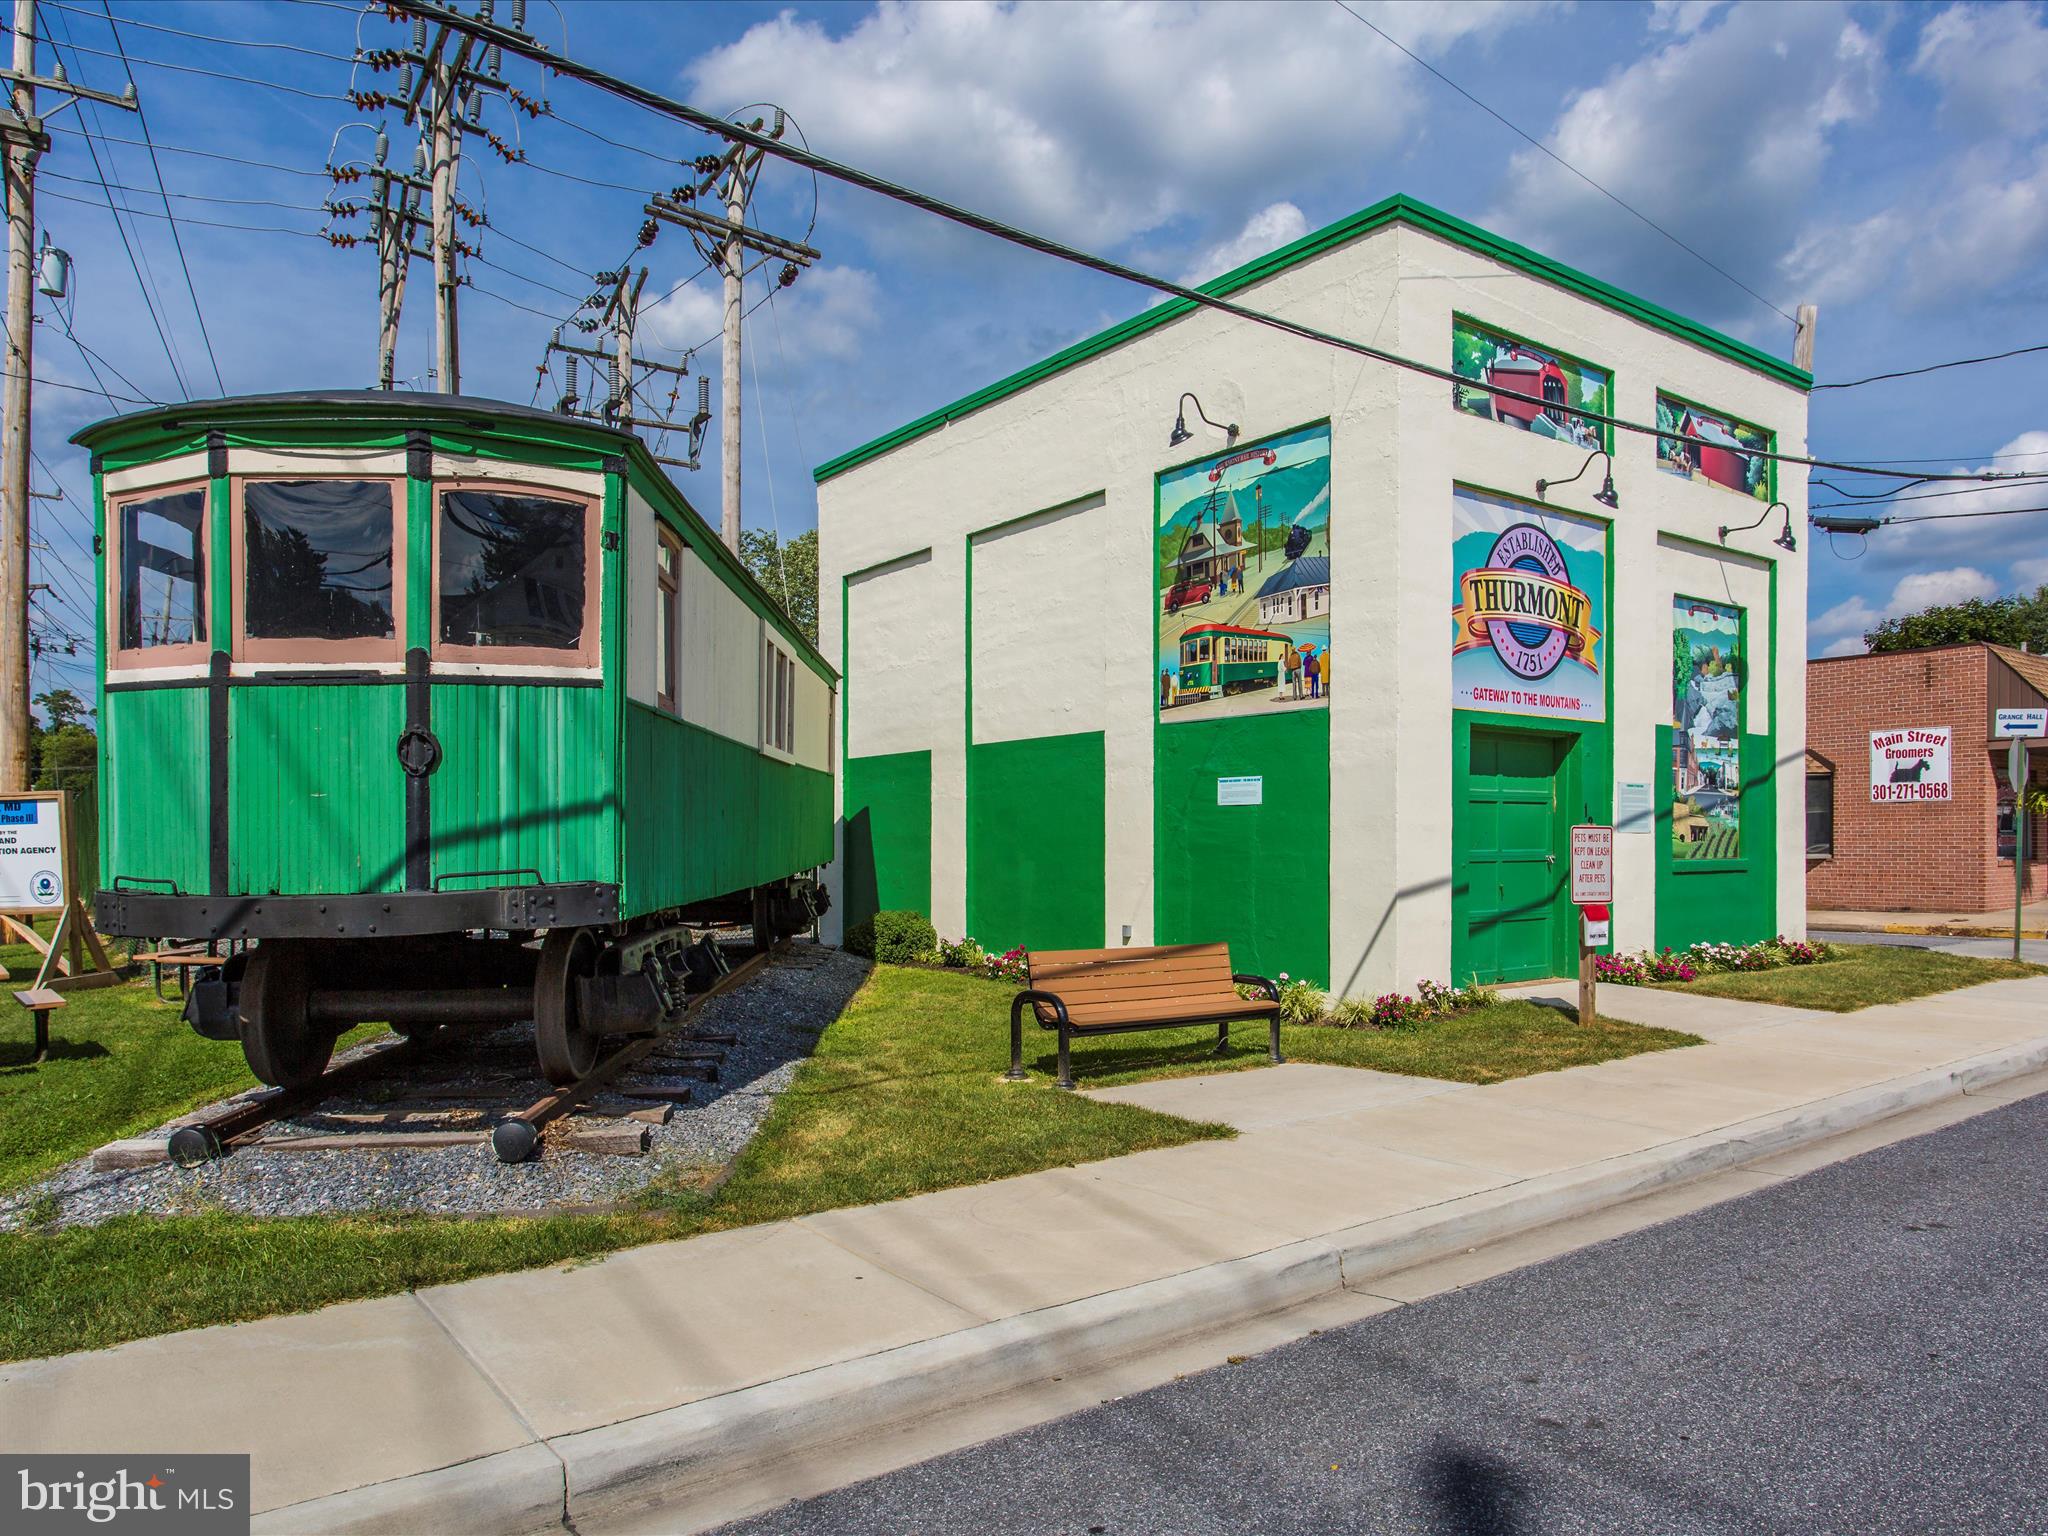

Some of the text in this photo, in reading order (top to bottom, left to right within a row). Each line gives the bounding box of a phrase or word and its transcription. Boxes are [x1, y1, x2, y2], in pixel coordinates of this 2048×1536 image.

[1496, 532, 1562, 576] ESTABLISHED
[1469, 579, 1585, 628] THURMONT
[1516, 650, 1543, 672] 1751
[1473, 687, 1581, 711] GATEWAY TO THE MOUNTAINS
[1873, 730, 1947, 750] Main Street
[1885, 747, 1934, 759] Groomers
[1872, 782, 1949, 800] 301-271-0568
[4, 802, 21, 811] MD
[1, 814, 34, 823] Phase III
[1574, 833, 1610, 842] PETS MUST BE
[1574, 847, 1610, 856] KEPT ON LEASH
[1580, 860, 1604, 870] CLEAN UP
[1578, 873, 1606, 883] AFTER PETS
